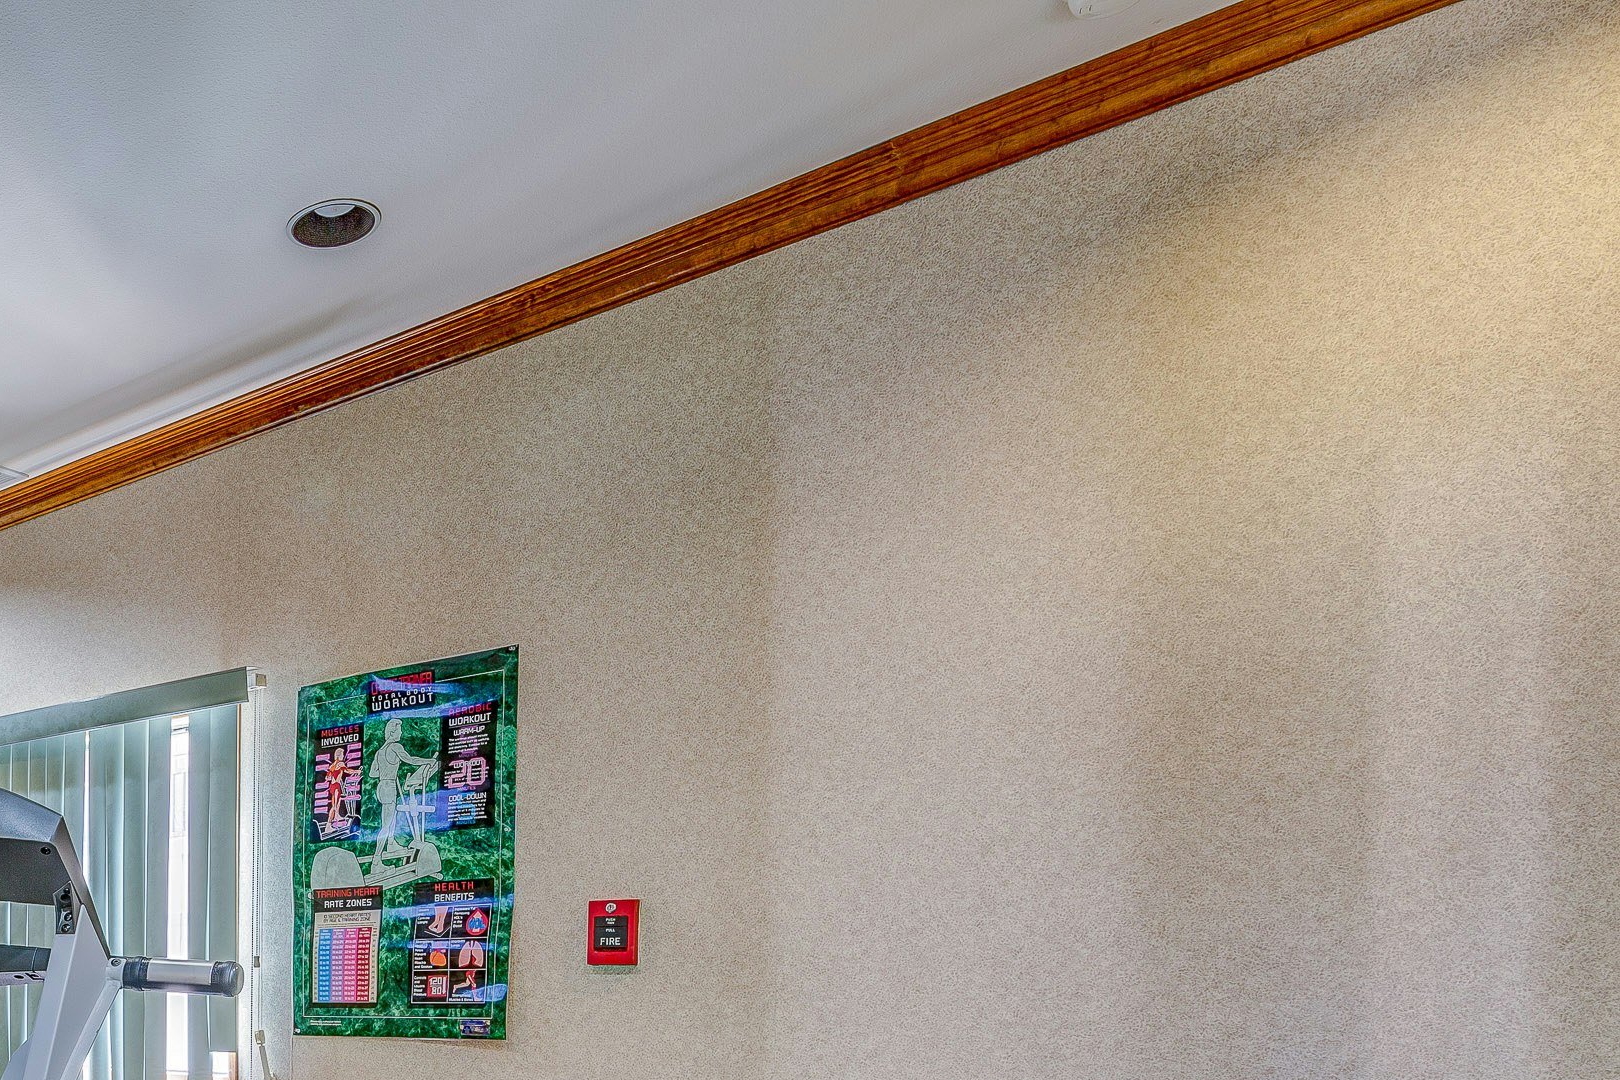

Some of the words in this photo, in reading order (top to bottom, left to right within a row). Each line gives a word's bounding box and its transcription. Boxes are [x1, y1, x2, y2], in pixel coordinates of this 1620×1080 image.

[372, 692, 402, 702] TOTAL
[406, 686, 432, 696] BODY
[371, 692, 434, 712] WORKOUT
[448, 702, 492, 717] AEROBIC
[448, 712, 492, 727] WORKOUT
[321, 724, 360, 737] MUSCLES
[321, 733, 360, 747] INVOLVED
[447, 757, 487, 789] 20
[316, 888, 352, 899] TRAINING
[353, 886, 380, 897] HEART
[434, 881, 475, 892] HEALTH
[324, 900, 344, 909] RATE
[345, 898, 373, 908] ZONES
[434, 892, 475, 902] BENEFITS
[600, 937, 621, 946] FIRE
